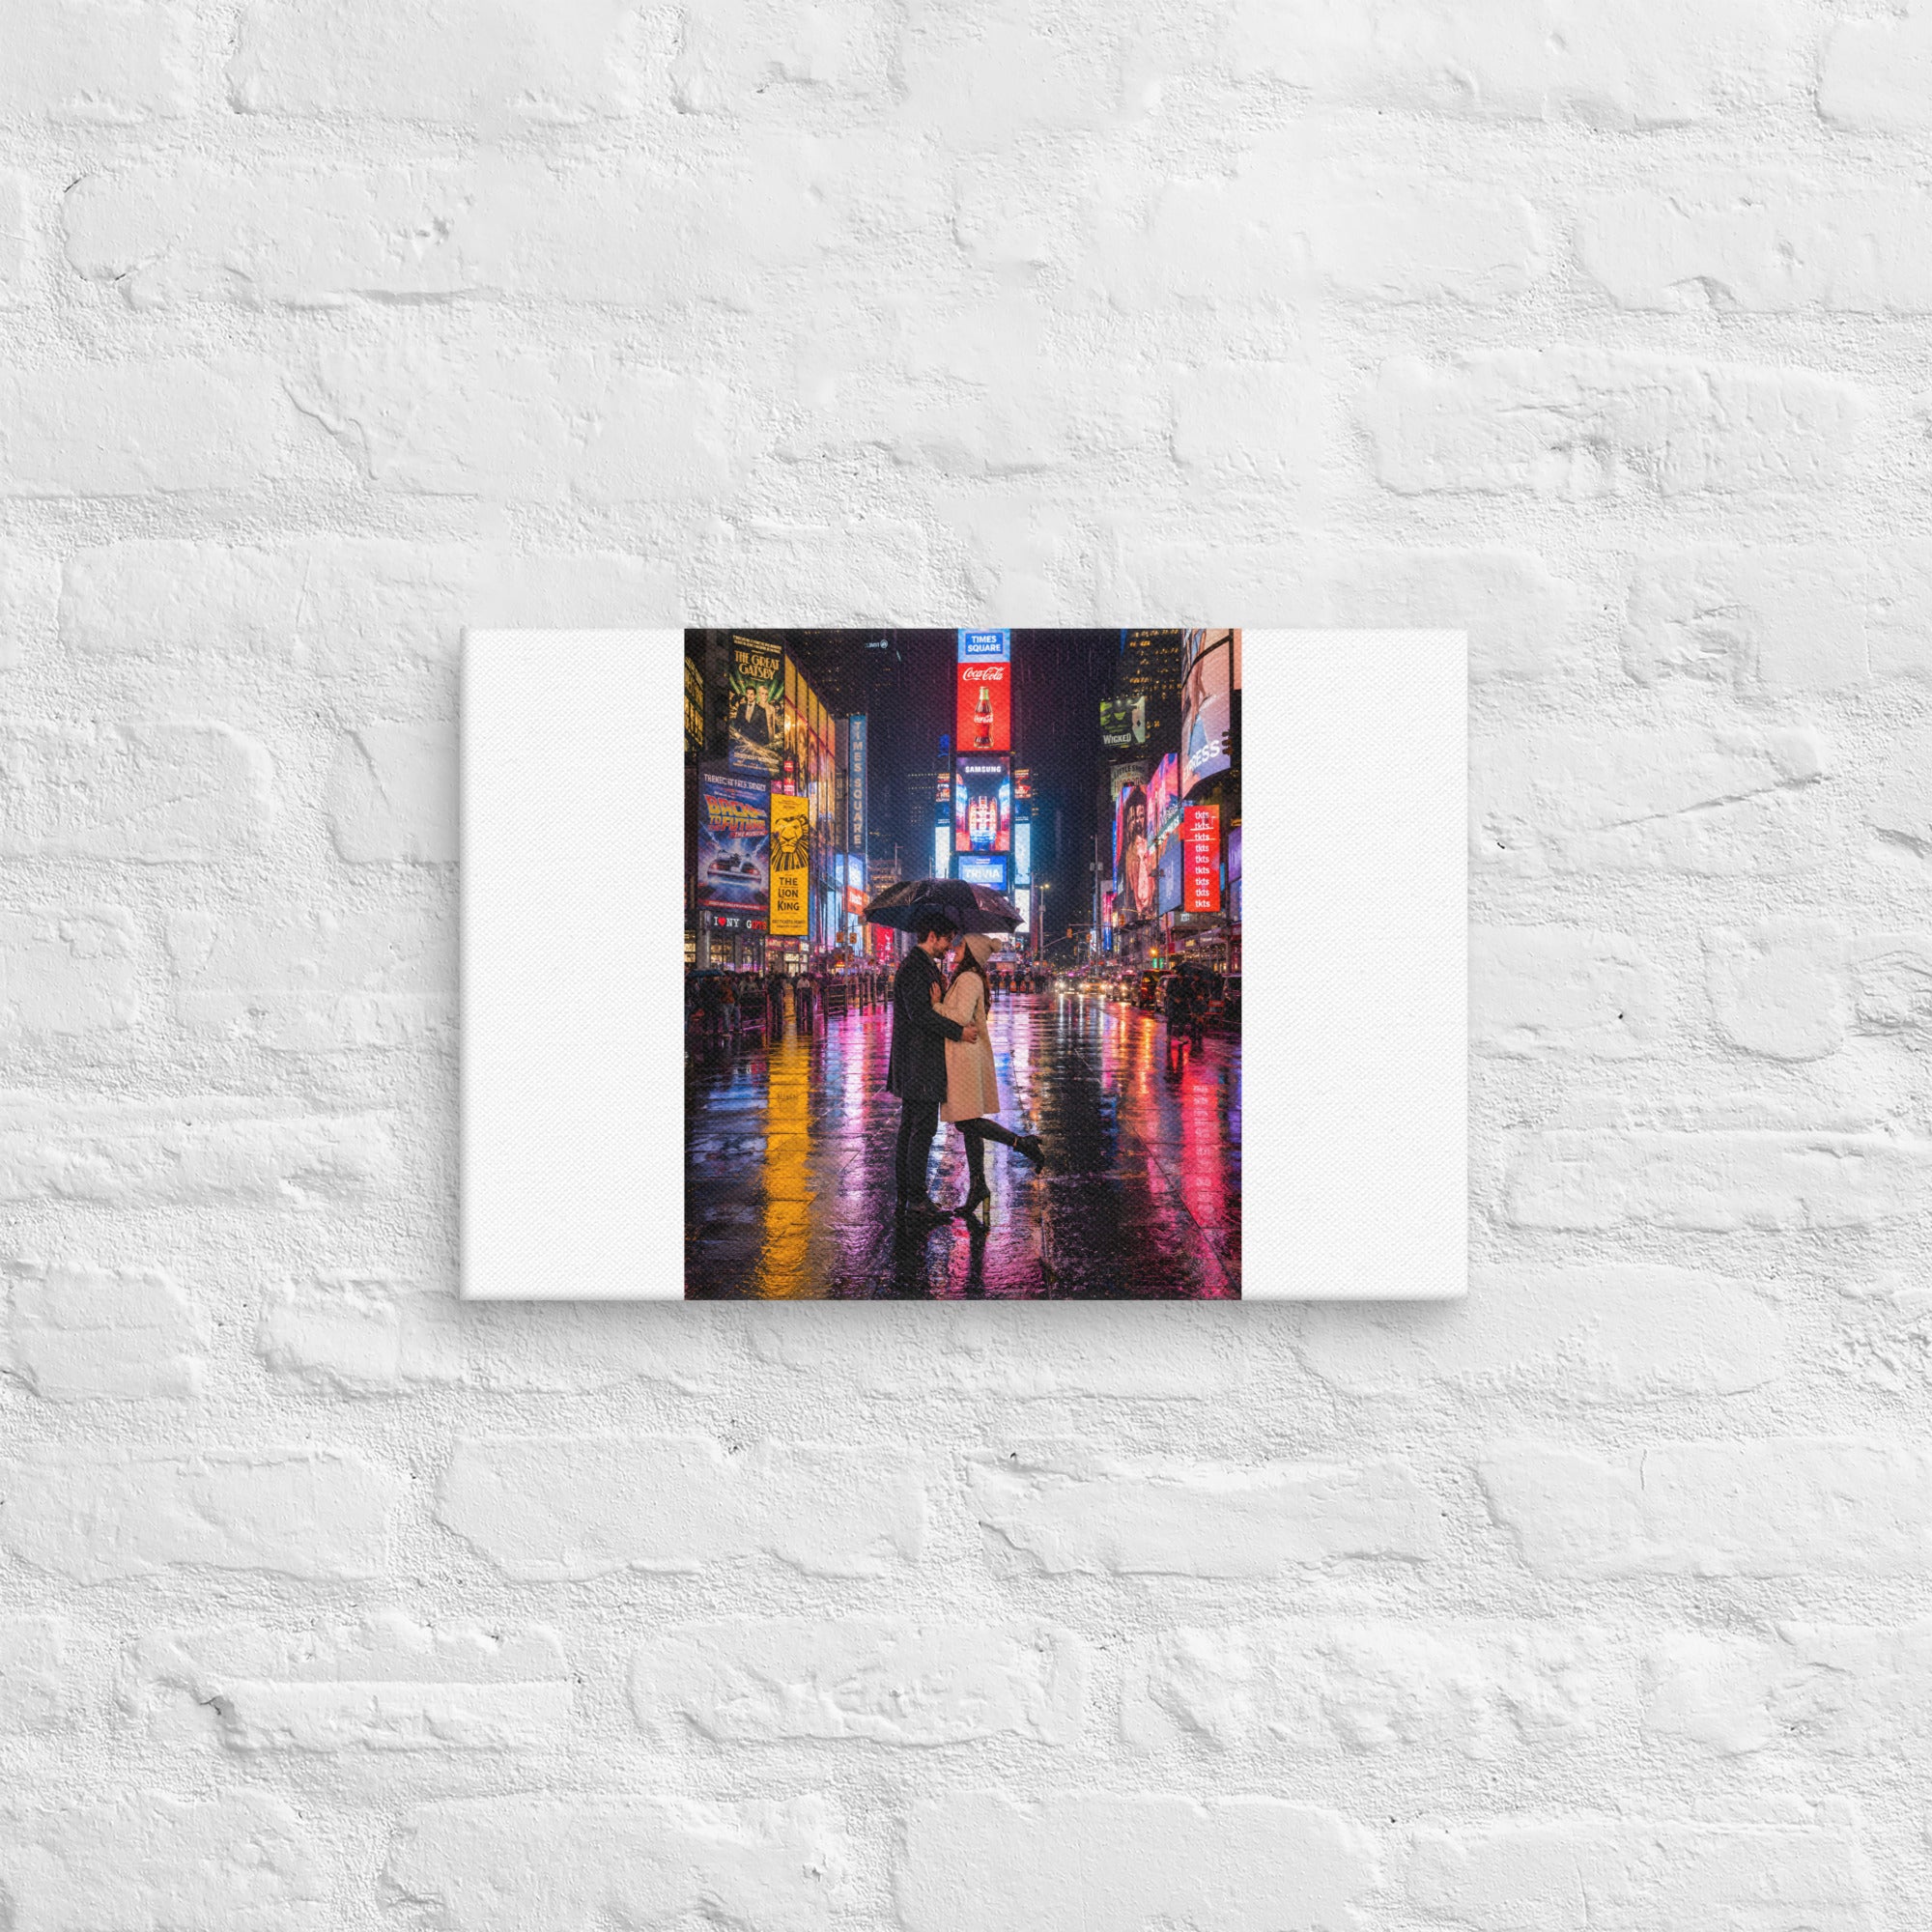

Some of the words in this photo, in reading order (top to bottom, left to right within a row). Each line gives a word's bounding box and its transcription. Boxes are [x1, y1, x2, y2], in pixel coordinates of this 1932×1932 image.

[734, 650, 750, 664] THE
[751, 654, 781, 670] GREAT
[738, 663, 776, 680] GATSBY
[1103, 732, 1131, 745] WICKED
[853, 721, 863, 772] TIMES
[964, 765, 1002, 774] SAMSUNG
[853, 778, 863, 845] SQUARE
[779, 876, 798, 886] THE
[778, 888, 799, 898] LION
[1195, 889, 1209, 897] tkts
[777, 900, 800, 911] KING
[726, 918, 739, 927] NY
[746, 920, 767, 930] GIFTS
